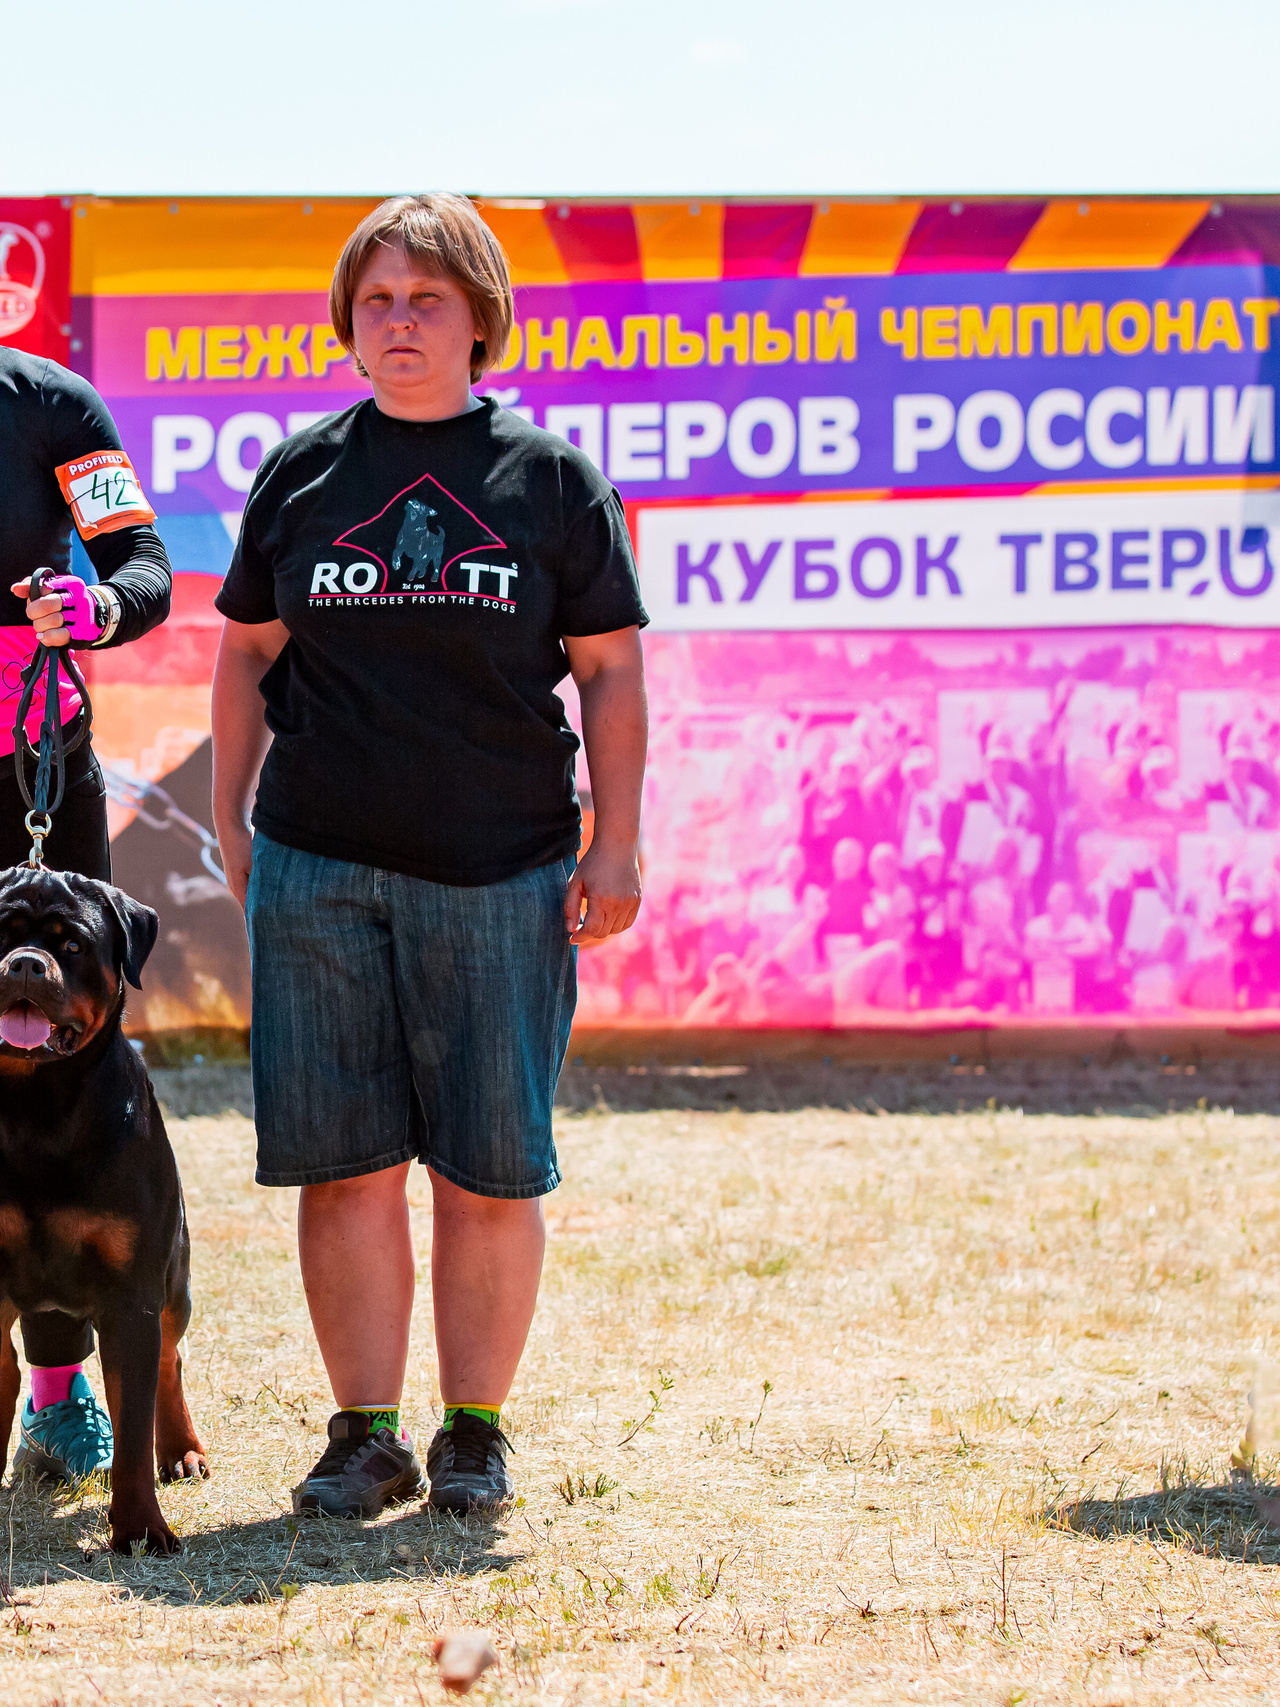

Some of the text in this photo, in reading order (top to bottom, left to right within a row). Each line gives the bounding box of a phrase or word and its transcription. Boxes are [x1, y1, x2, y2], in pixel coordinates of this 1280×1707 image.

[881, 299, 1280, 361] ЧЕМПИОНАТ
[892, 385, 1276, 475] РОССИИ
[90, 471, 140, 509] 42
[675, 534, 963, 606] КУБОК
[308, 595, 516, 613] THE MERCEDES FROM THE DOGS
